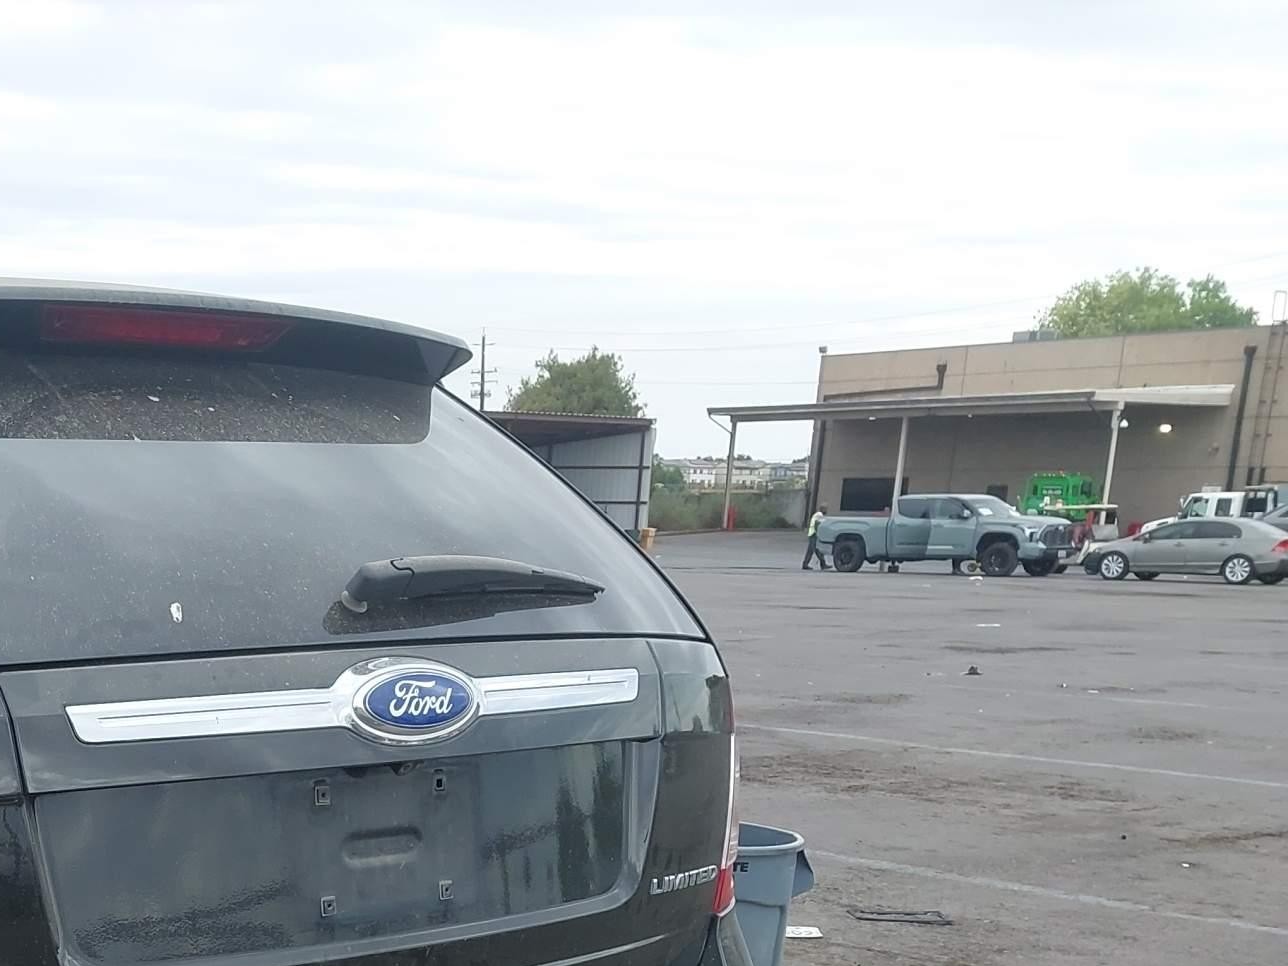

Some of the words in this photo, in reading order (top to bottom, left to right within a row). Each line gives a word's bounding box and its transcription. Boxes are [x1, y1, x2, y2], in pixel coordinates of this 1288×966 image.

[389, 679, 453, 717] Ford
[650, 865, 718, 895] LIMITED
[732, 861, 749, 872] TE
